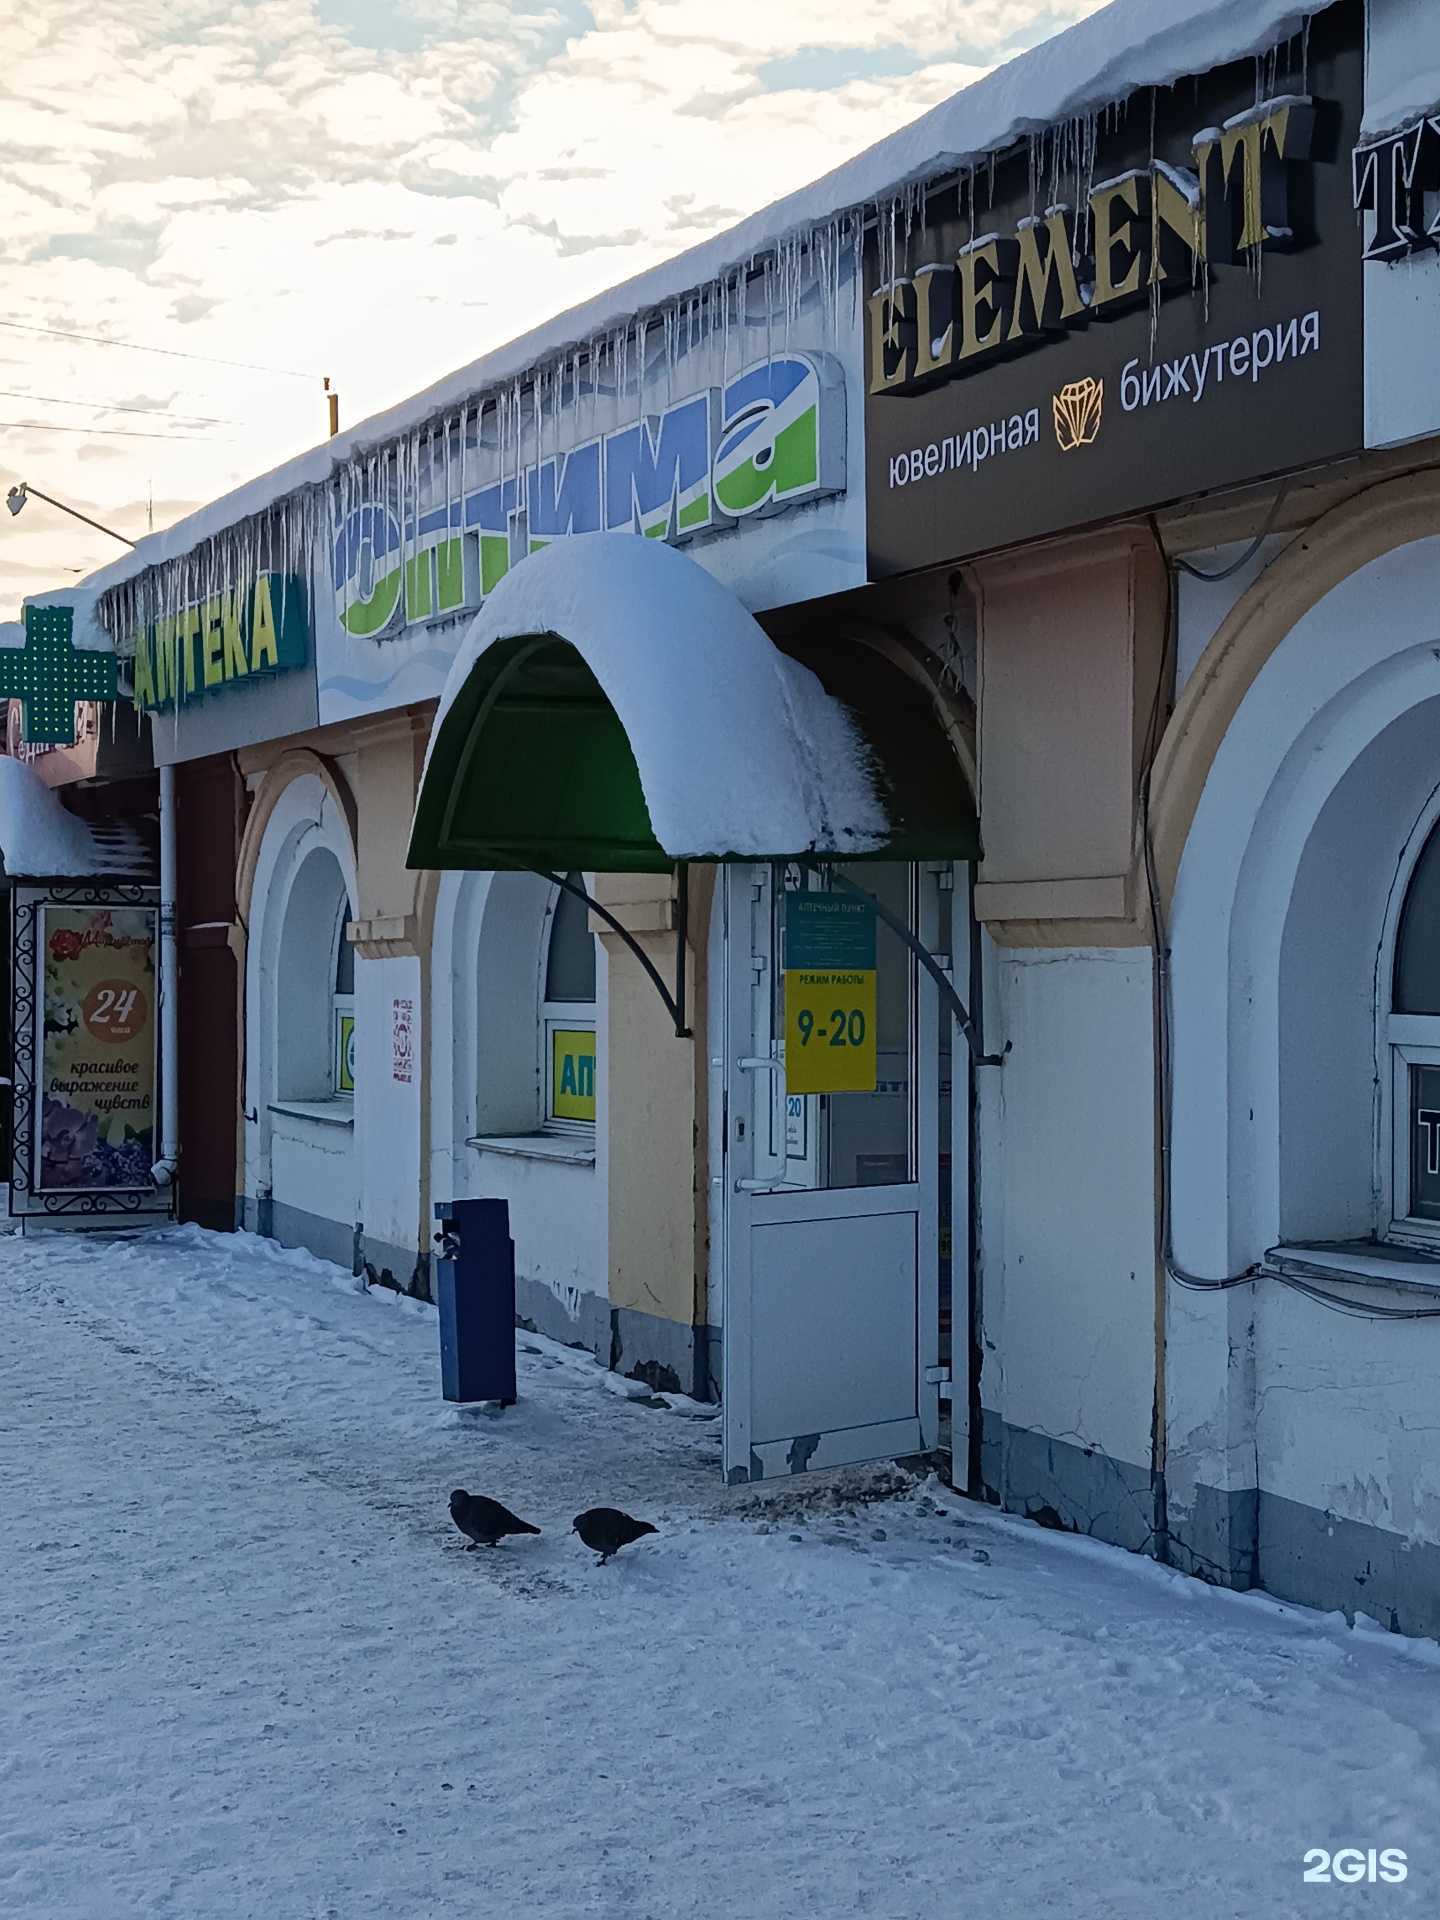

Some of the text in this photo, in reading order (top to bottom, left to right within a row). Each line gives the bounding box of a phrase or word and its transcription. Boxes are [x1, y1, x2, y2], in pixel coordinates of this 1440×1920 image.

[868, 102, 1292, 394] ELEMENT
[888, 309, 1322, 489] ювелирная бижутерия
[134, 575, 279, 712] АПТЕКА
[799, 974, 865, 985] РЕЖИМ РАБОТЫ
[90, 989, 138, 1023] 24
[797, 1008, 866, 1047] 9-20
[70, 1058, 139, 1078] красивое
[559, 1054, 597, 1097] АП
[50, 1077, 139, 1097] выражение
[94, 1093, 150, 1114] чувств
